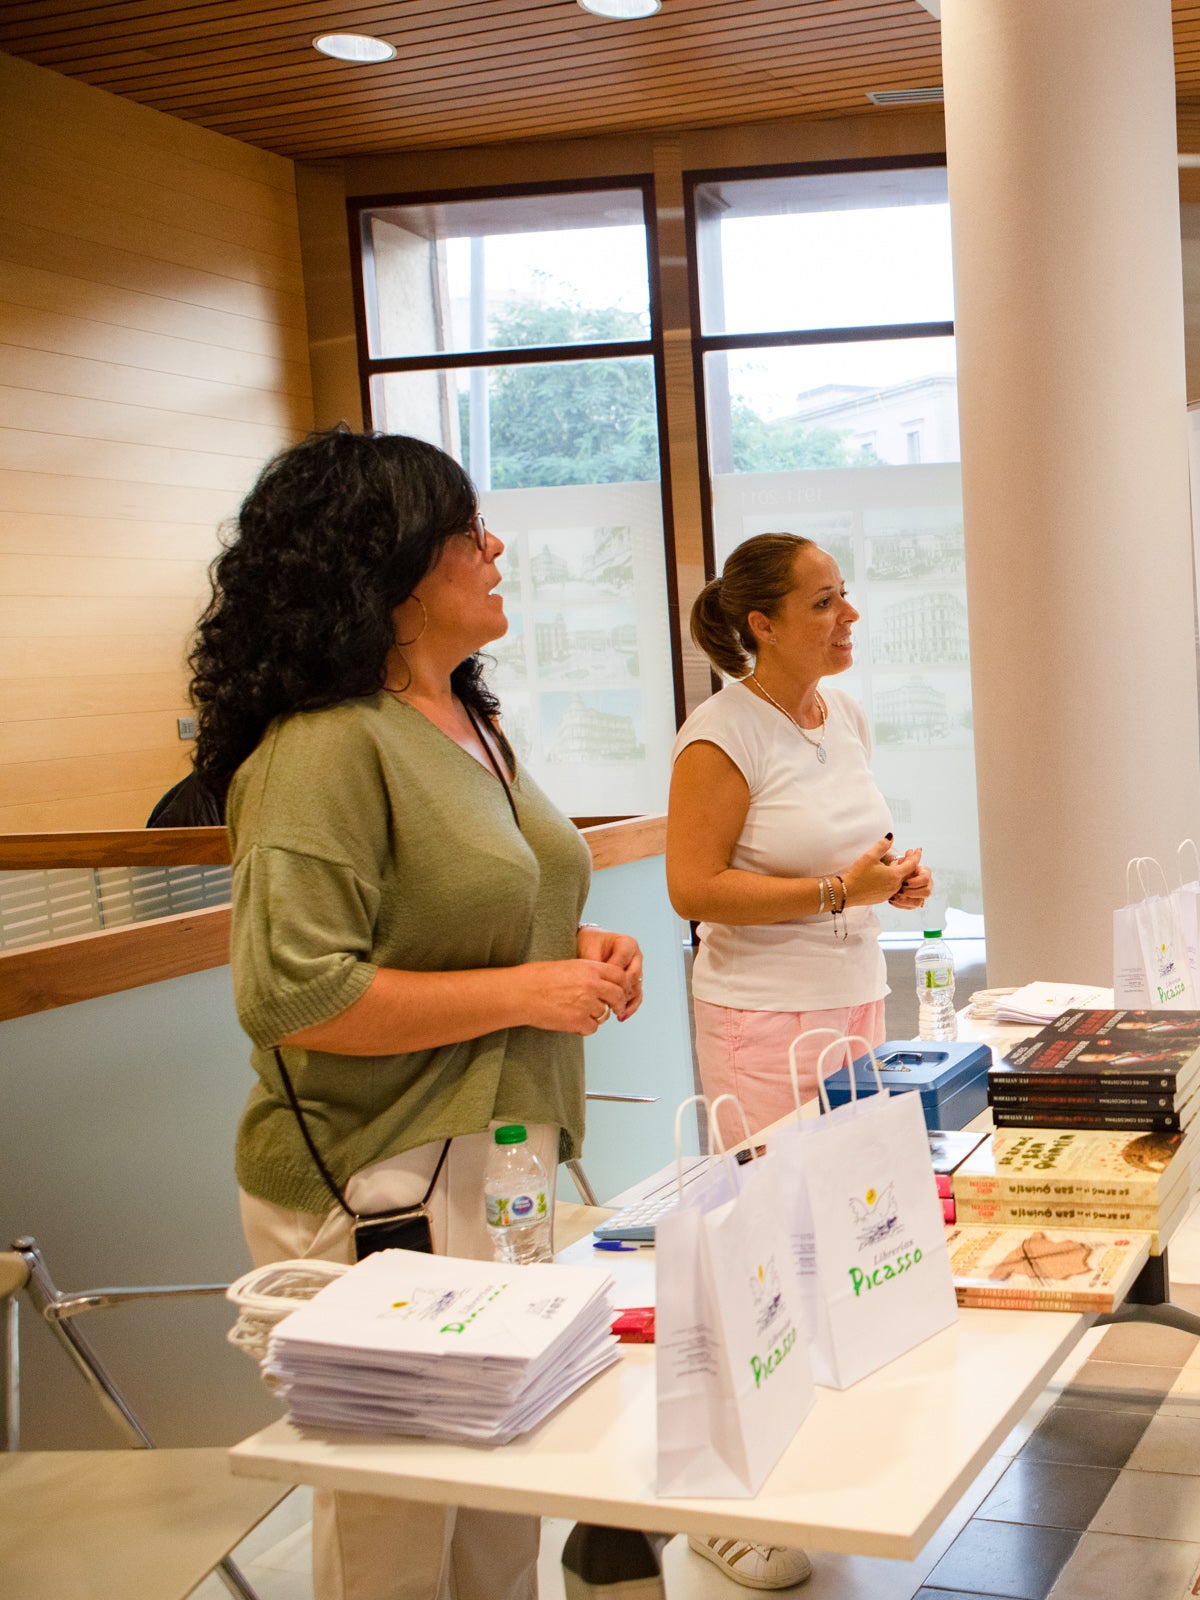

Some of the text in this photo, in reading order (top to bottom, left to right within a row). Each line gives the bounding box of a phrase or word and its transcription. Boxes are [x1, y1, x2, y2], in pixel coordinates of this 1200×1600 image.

[1157, 982, 1186, 1004] Picasso
[848, 1247, 923, 1297] Picasso
[750, 1327, 796, 1389] Picasso
